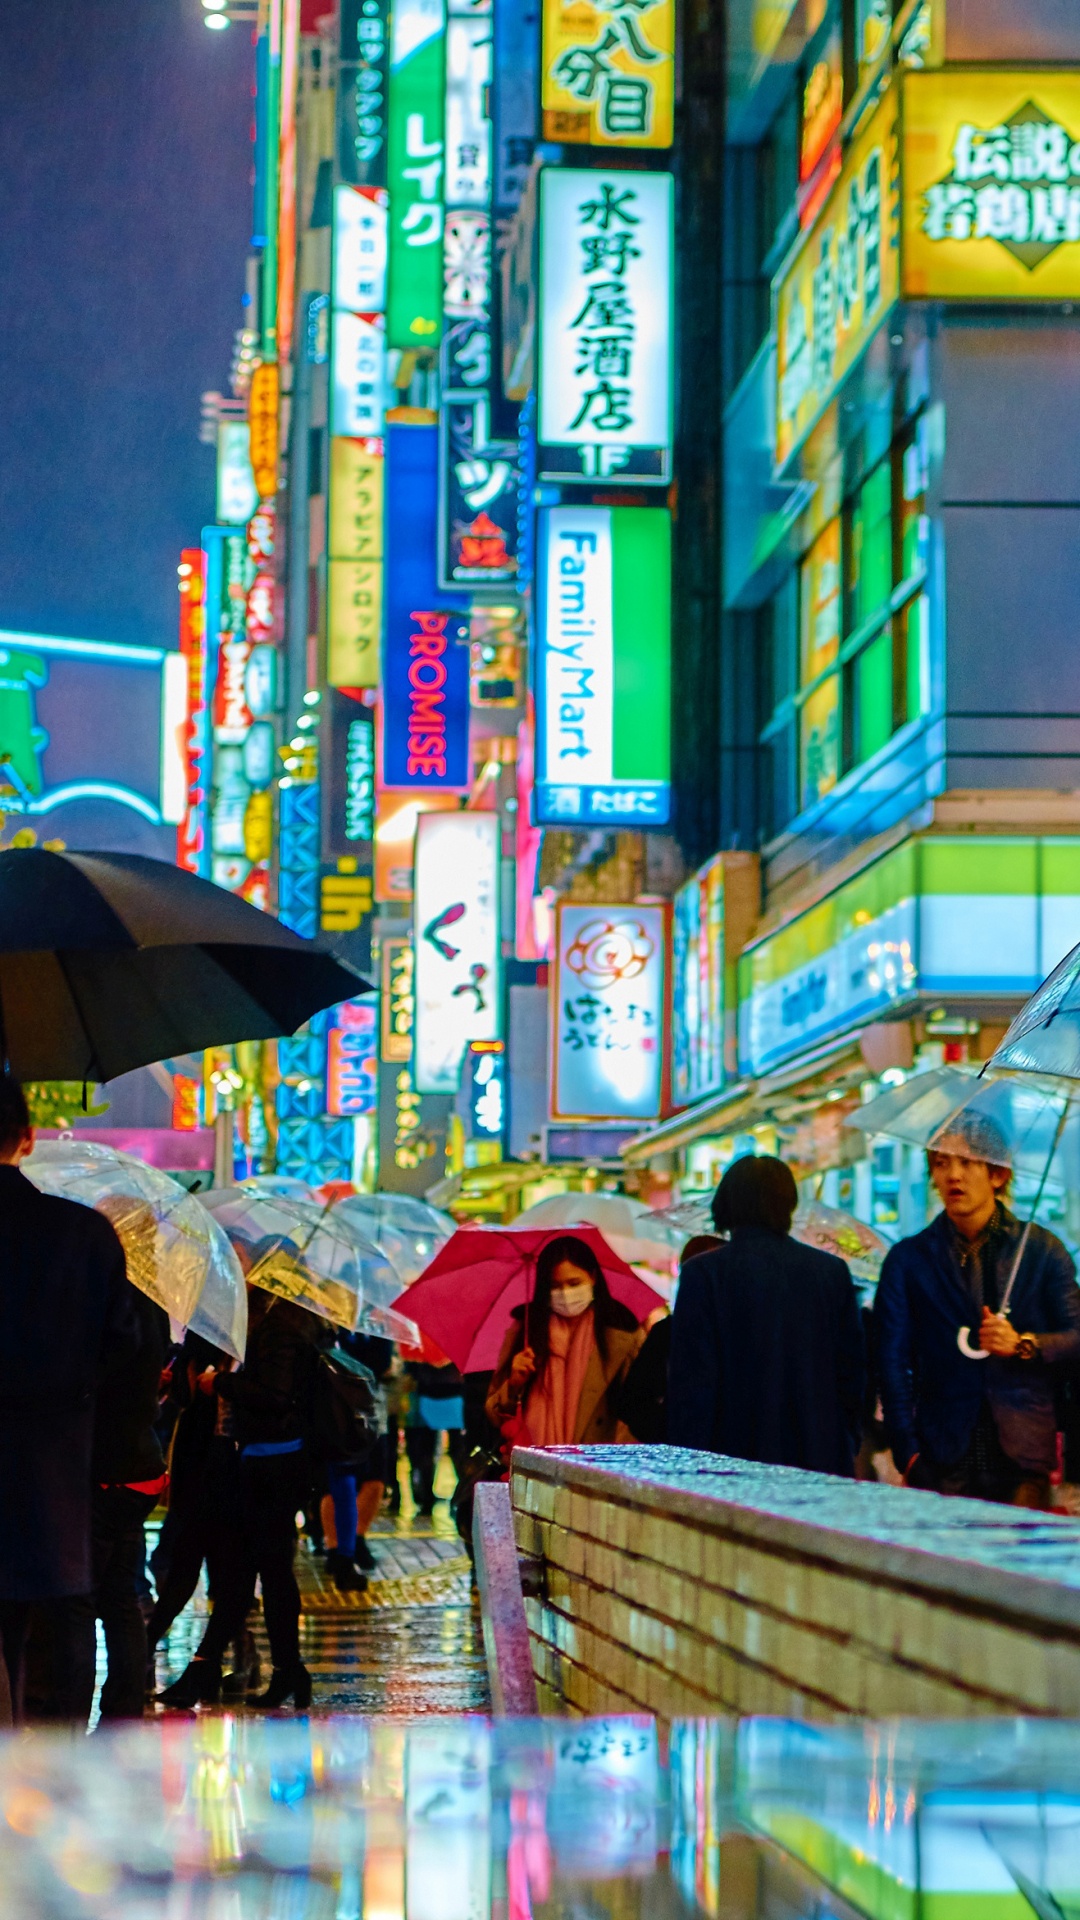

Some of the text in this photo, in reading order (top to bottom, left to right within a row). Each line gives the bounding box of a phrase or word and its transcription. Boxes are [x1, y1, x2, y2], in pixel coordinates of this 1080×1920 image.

[557, 0, 659, 133] 八分目
[402, 114, 442, 245] レイク
[953, 122, 1080, 182] 伝説
[568, 183, 642, 432] 水野屋酒店
[408, 610, 449, 777] PROMISE
[545, 531, 598, 760] FamilyMart
